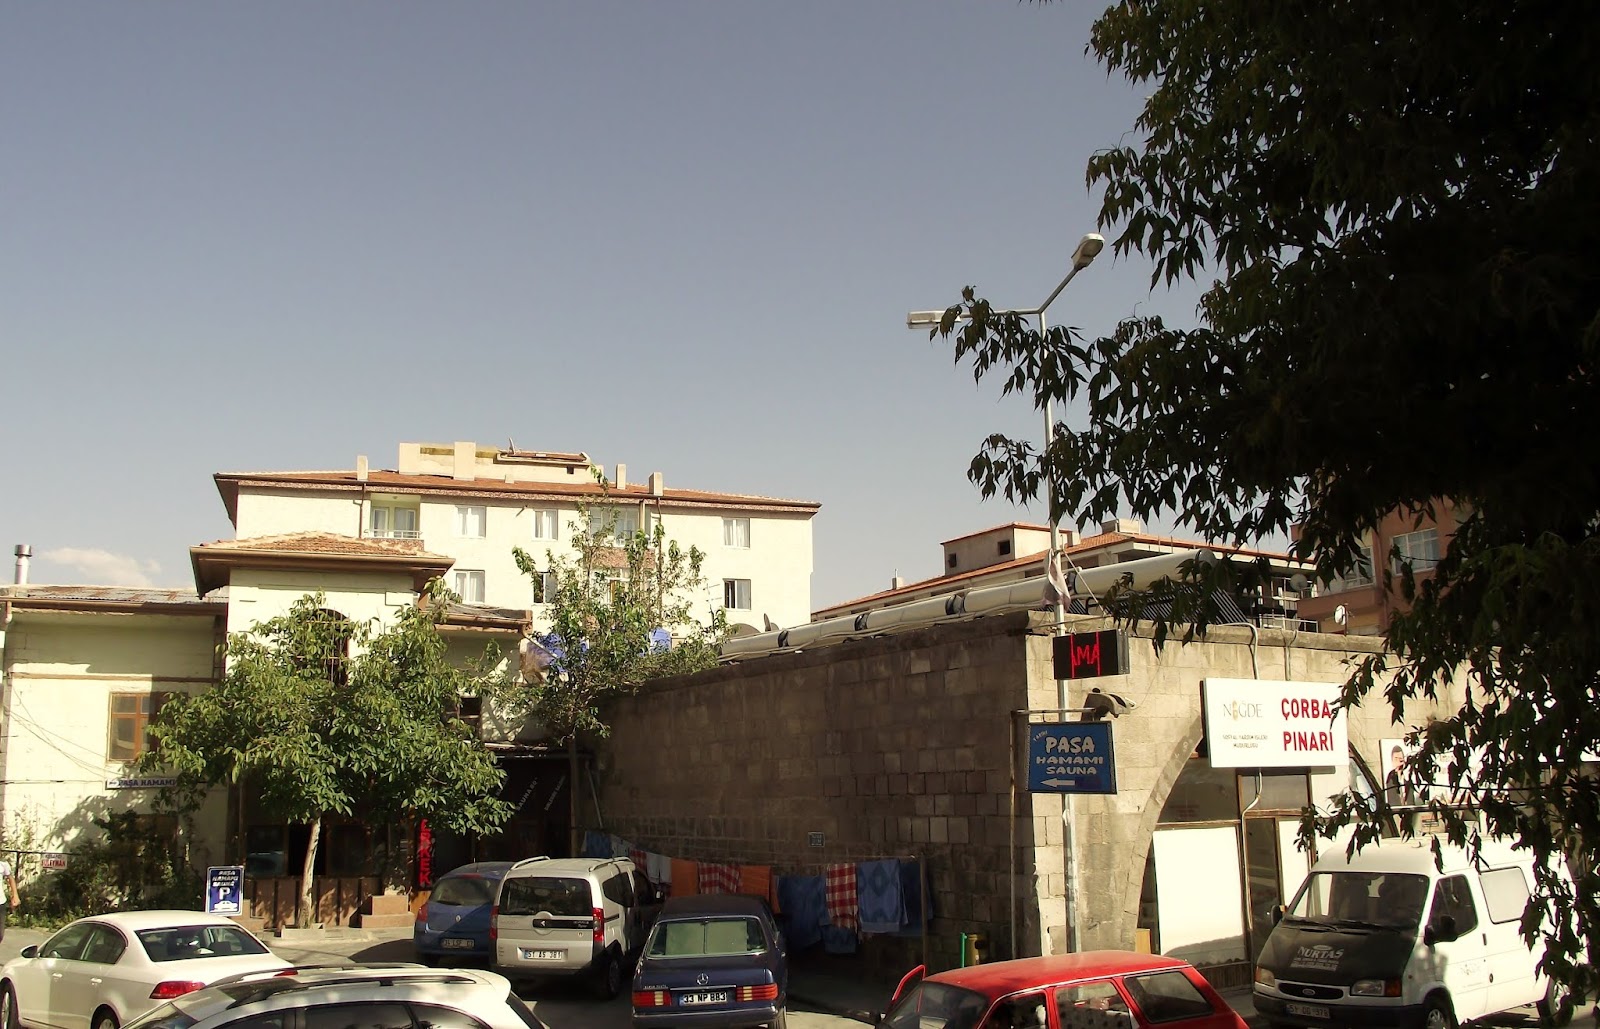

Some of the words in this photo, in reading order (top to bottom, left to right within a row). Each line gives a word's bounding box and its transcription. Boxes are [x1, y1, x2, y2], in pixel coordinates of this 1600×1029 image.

[1281, 698, 1332, 721] ÇORBA
[1045, 736, 1095, 756] PAŞA
[1036, 756, 1104, 765] HAMAMI
[1046, 766, 1097, 775] SAUNA
[219, 887, 231, 900] P
[684, 995, 694, 1003] 33
[698, 993, 708, 1002] NP
[710, 992, 726, 1002] 883
